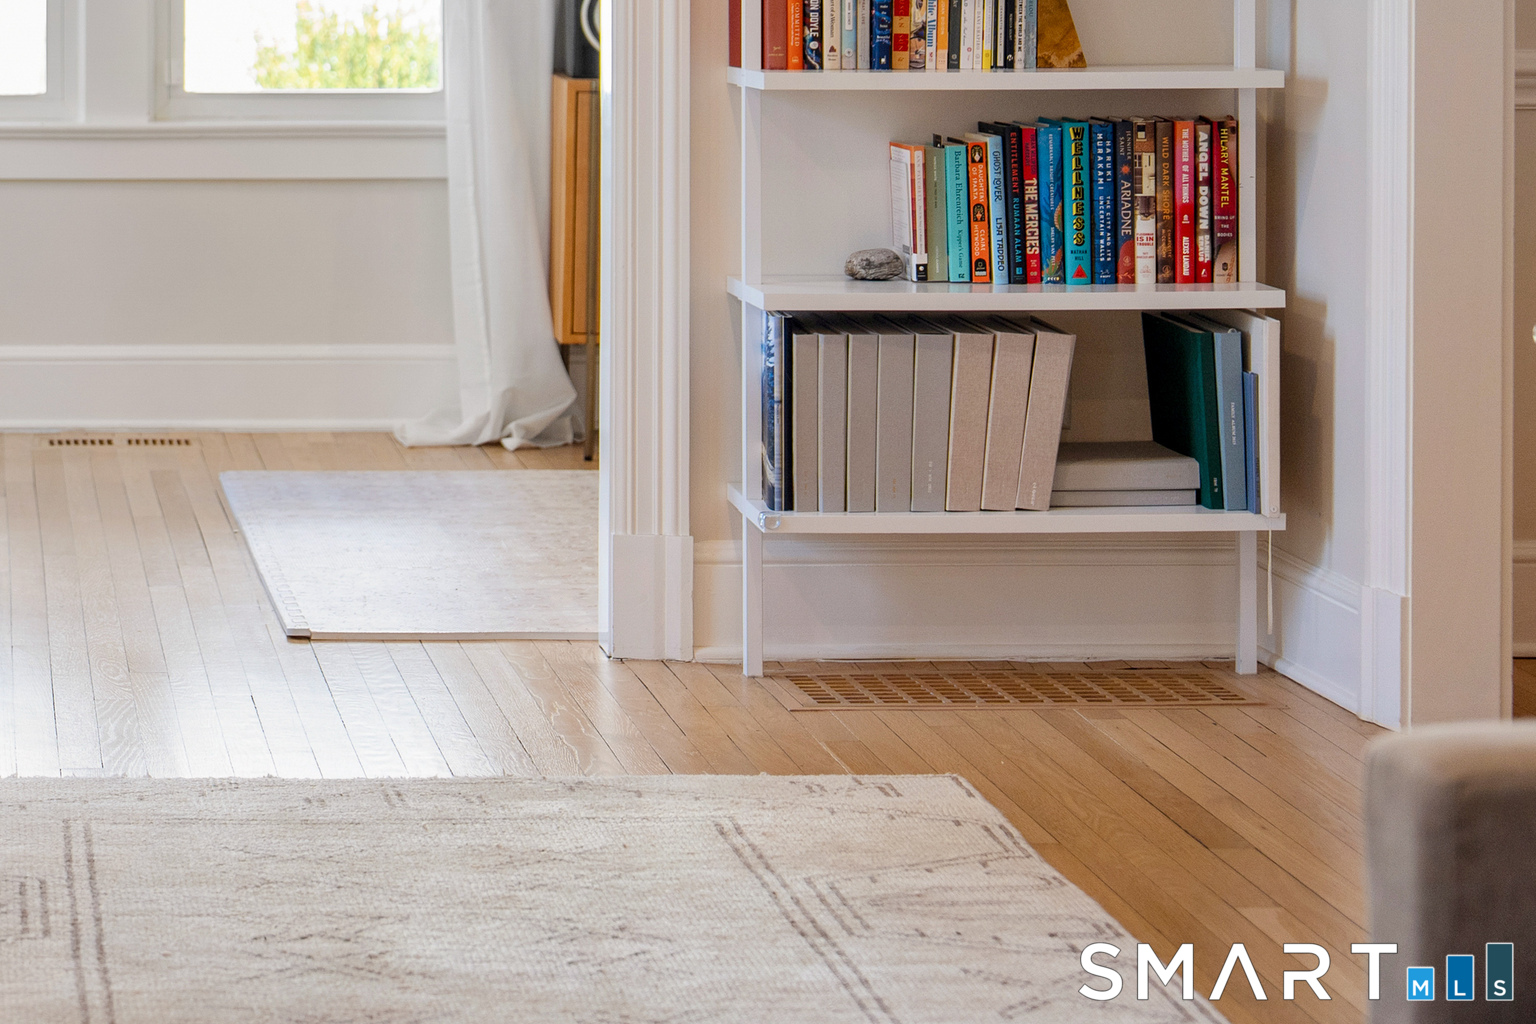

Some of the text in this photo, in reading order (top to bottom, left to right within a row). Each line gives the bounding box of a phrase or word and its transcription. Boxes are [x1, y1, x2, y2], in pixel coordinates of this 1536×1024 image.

[809, 12, 819, 37] DOYLE
[926, 18, 937, 48] Album
[953, 150, 964, 225] Barbara Ehrenreich
[992, 150, 1003, 203] GHOST LOVER
[1009, 131, 1020, 194] ENTITLEMENT
[1069, 126, 1086, 247] WELLNESS
[1096, 133, 1104, 190] MURAKAMI
[1161, 136, 1171, 220] WILD DARK SHORE
[1198, 131, 1209, 230] ANGEL DOWN
[1220, 128, 1230, 208] HILARY MANTEL
[1012, 197, 1023, 263] RUMAAN ALAM
[1024, 177, 1039, 255] THE MERCIES
[1120, 179, 1132, 237] ARIADNE
[995, 217, 1005, 272] LISA TADDEO
